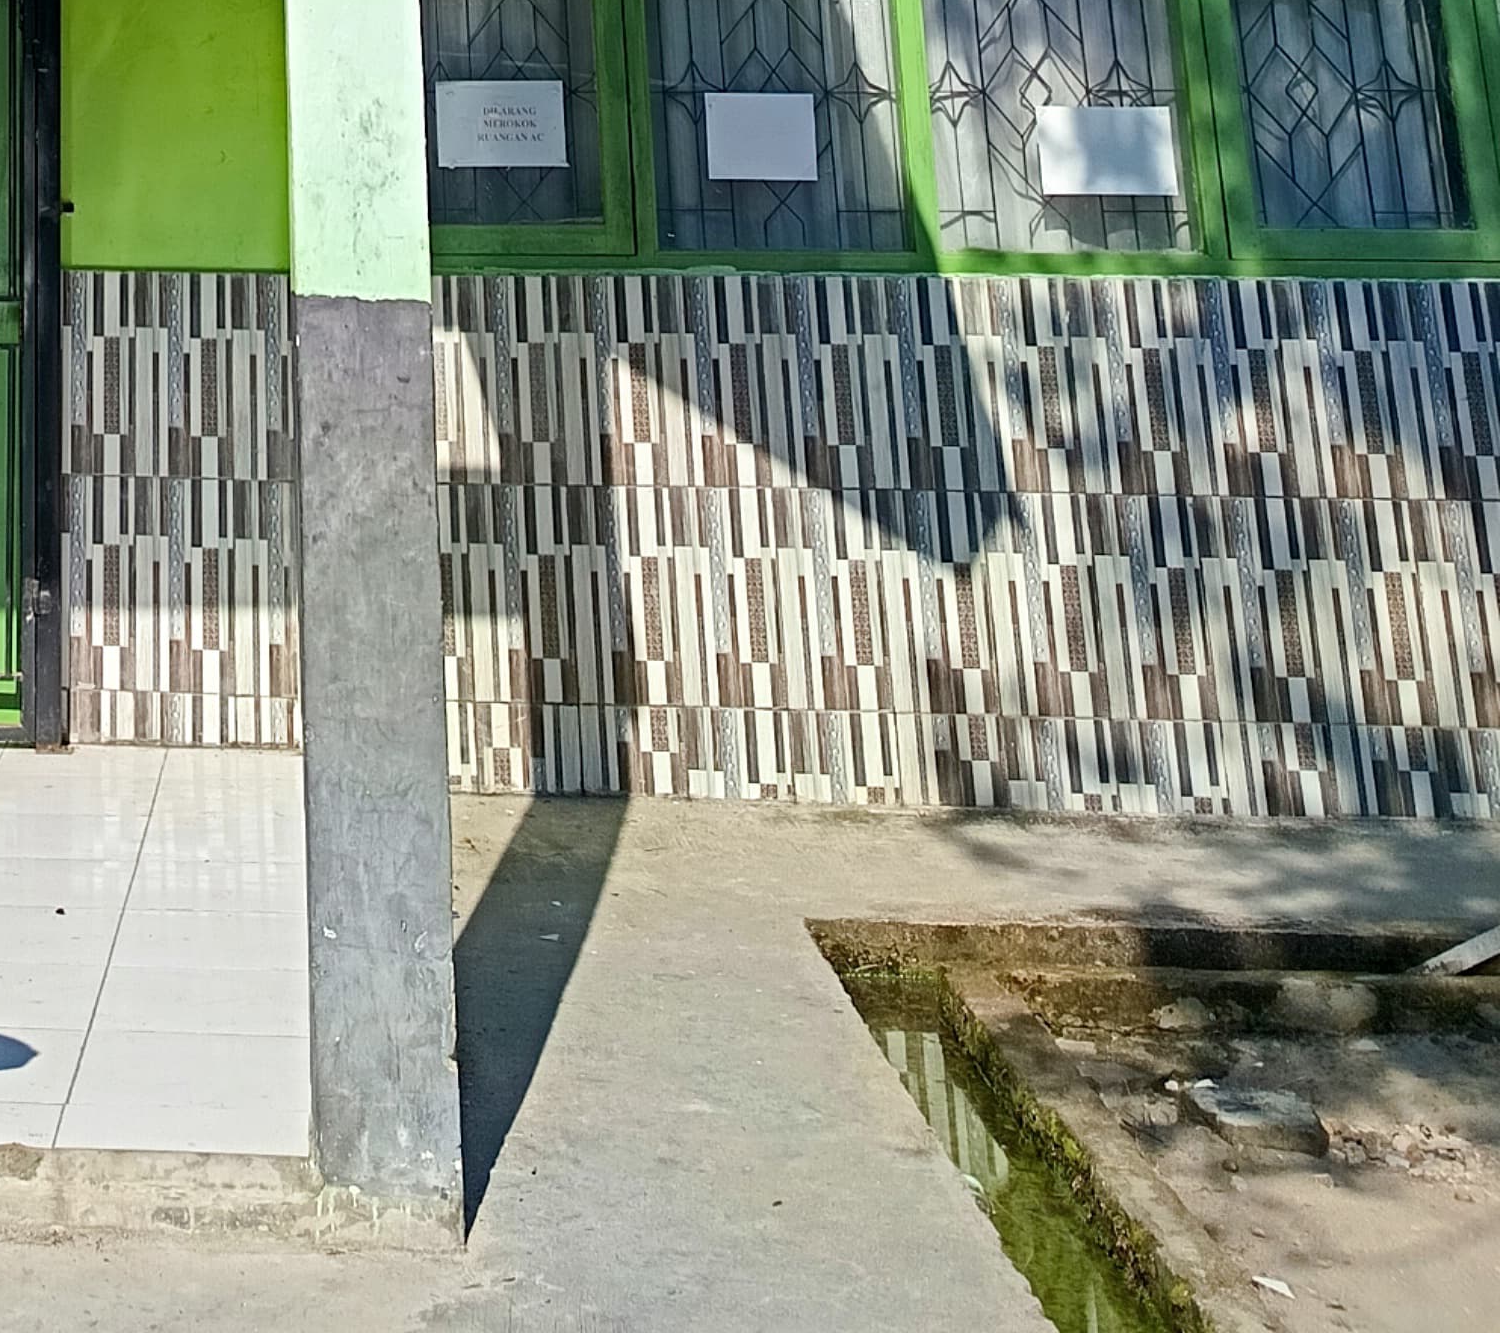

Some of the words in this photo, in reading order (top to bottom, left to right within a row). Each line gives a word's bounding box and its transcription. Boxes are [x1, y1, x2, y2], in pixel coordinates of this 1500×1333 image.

[483, 119, 537, 128] MEROKOK
[477, 132, 528, 142] RUANGAN
[531, 132, 545, 142] AC
